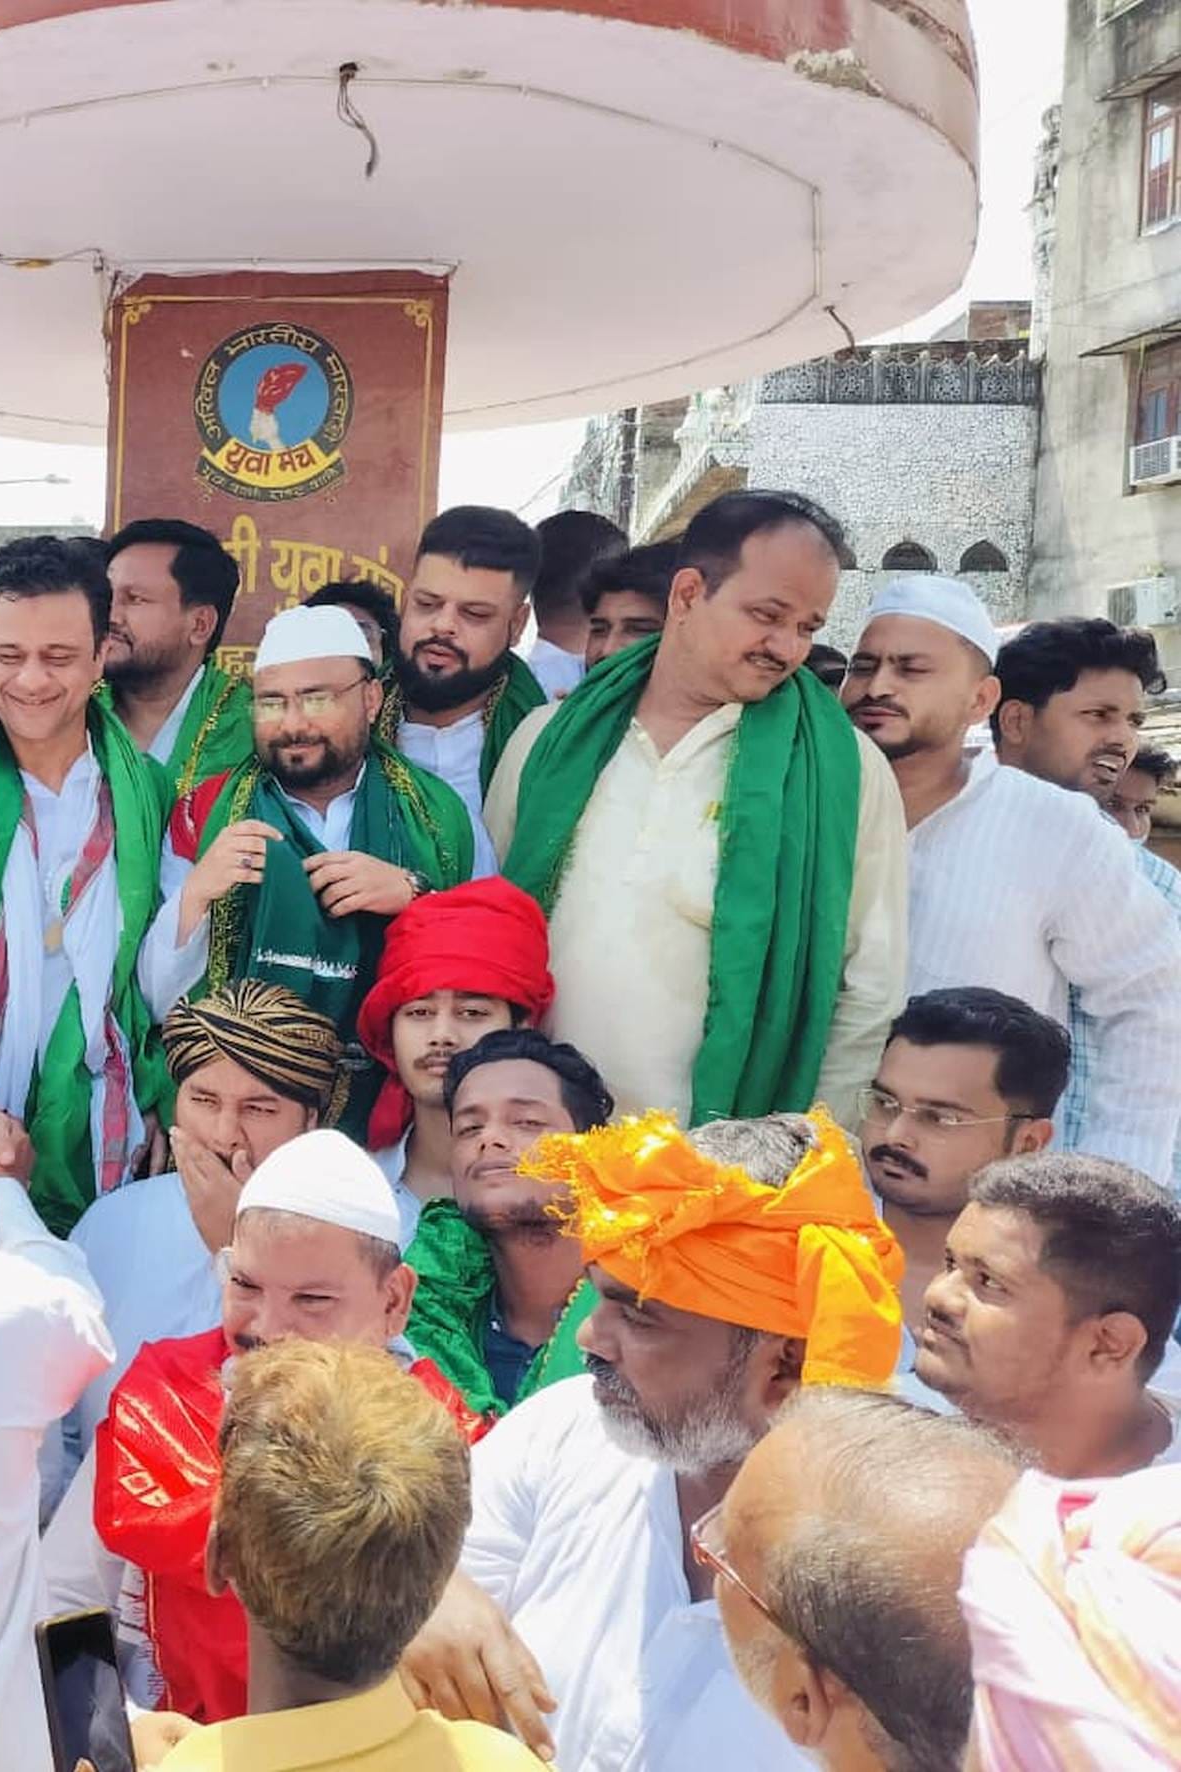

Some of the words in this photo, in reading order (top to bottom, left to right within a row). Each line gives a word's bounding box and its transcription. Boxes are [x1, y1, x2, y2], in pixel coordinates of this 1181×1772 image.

[194, 360, 221, 440] अखिल
[225, 442, 272, 476] युवा
[276, 444, 317, 472] मंच
